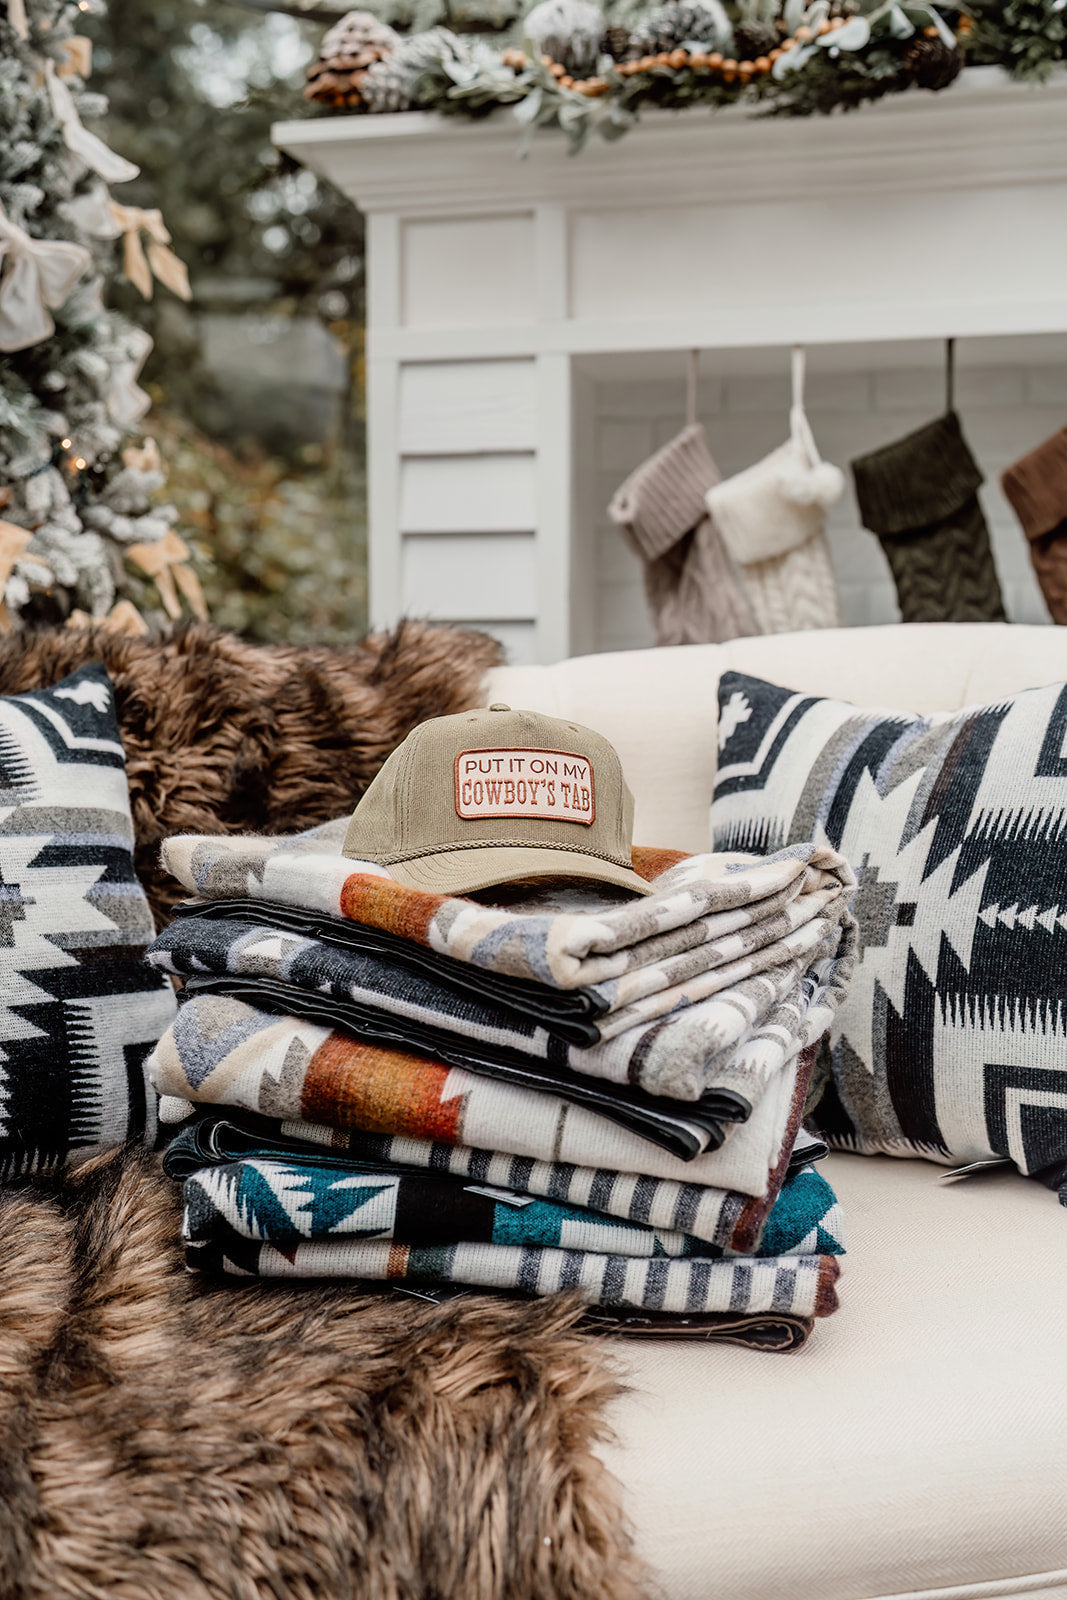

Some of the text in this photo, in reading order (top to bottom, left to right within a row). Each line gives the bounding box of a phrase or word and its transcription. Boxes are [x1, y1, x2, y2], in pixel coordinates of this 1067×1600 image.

[465, 758, 587, 780] PUT IT ON MY
[461, 778, 590, 812] COWBOY'S TAB
